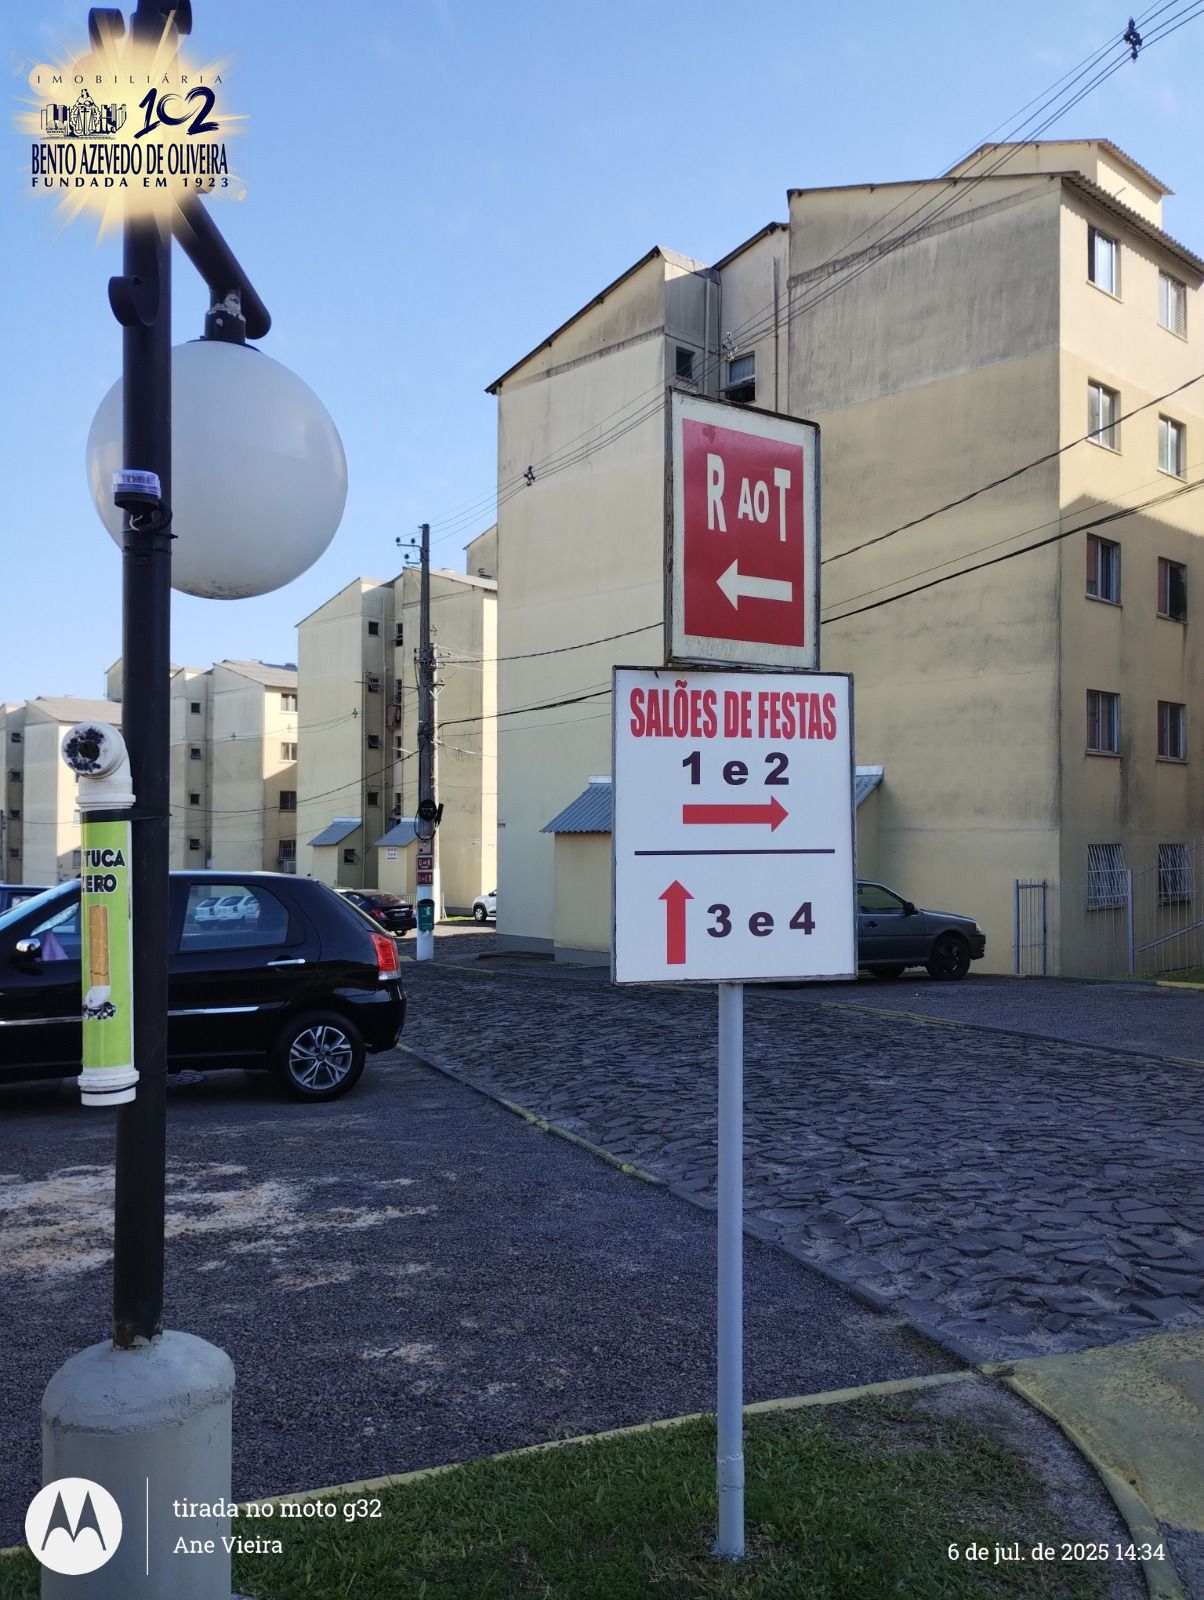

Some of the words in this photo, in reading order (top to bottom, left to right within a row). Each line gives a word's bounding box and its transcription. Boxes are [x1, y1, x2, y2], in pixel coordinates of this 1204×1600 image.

[706, 452, 727, 533] R
[737, 477, 770, 524] AO
[773, 466, 791, 542] T
[629, 679, 718, 739] SALÕES
[723, 690, 753, 739] DE
[758, 691, 837, 741] FESTAS
[682, 750, 702, 785] 1
[722, 760, 749, 786] e
[763, 751, 790, 786] 2
[82, 873, 118, 893] ERO
[706, 903, 732, 938] 3
[748, 911, 775, 937] e
[789, 901, 816, 936] 4
